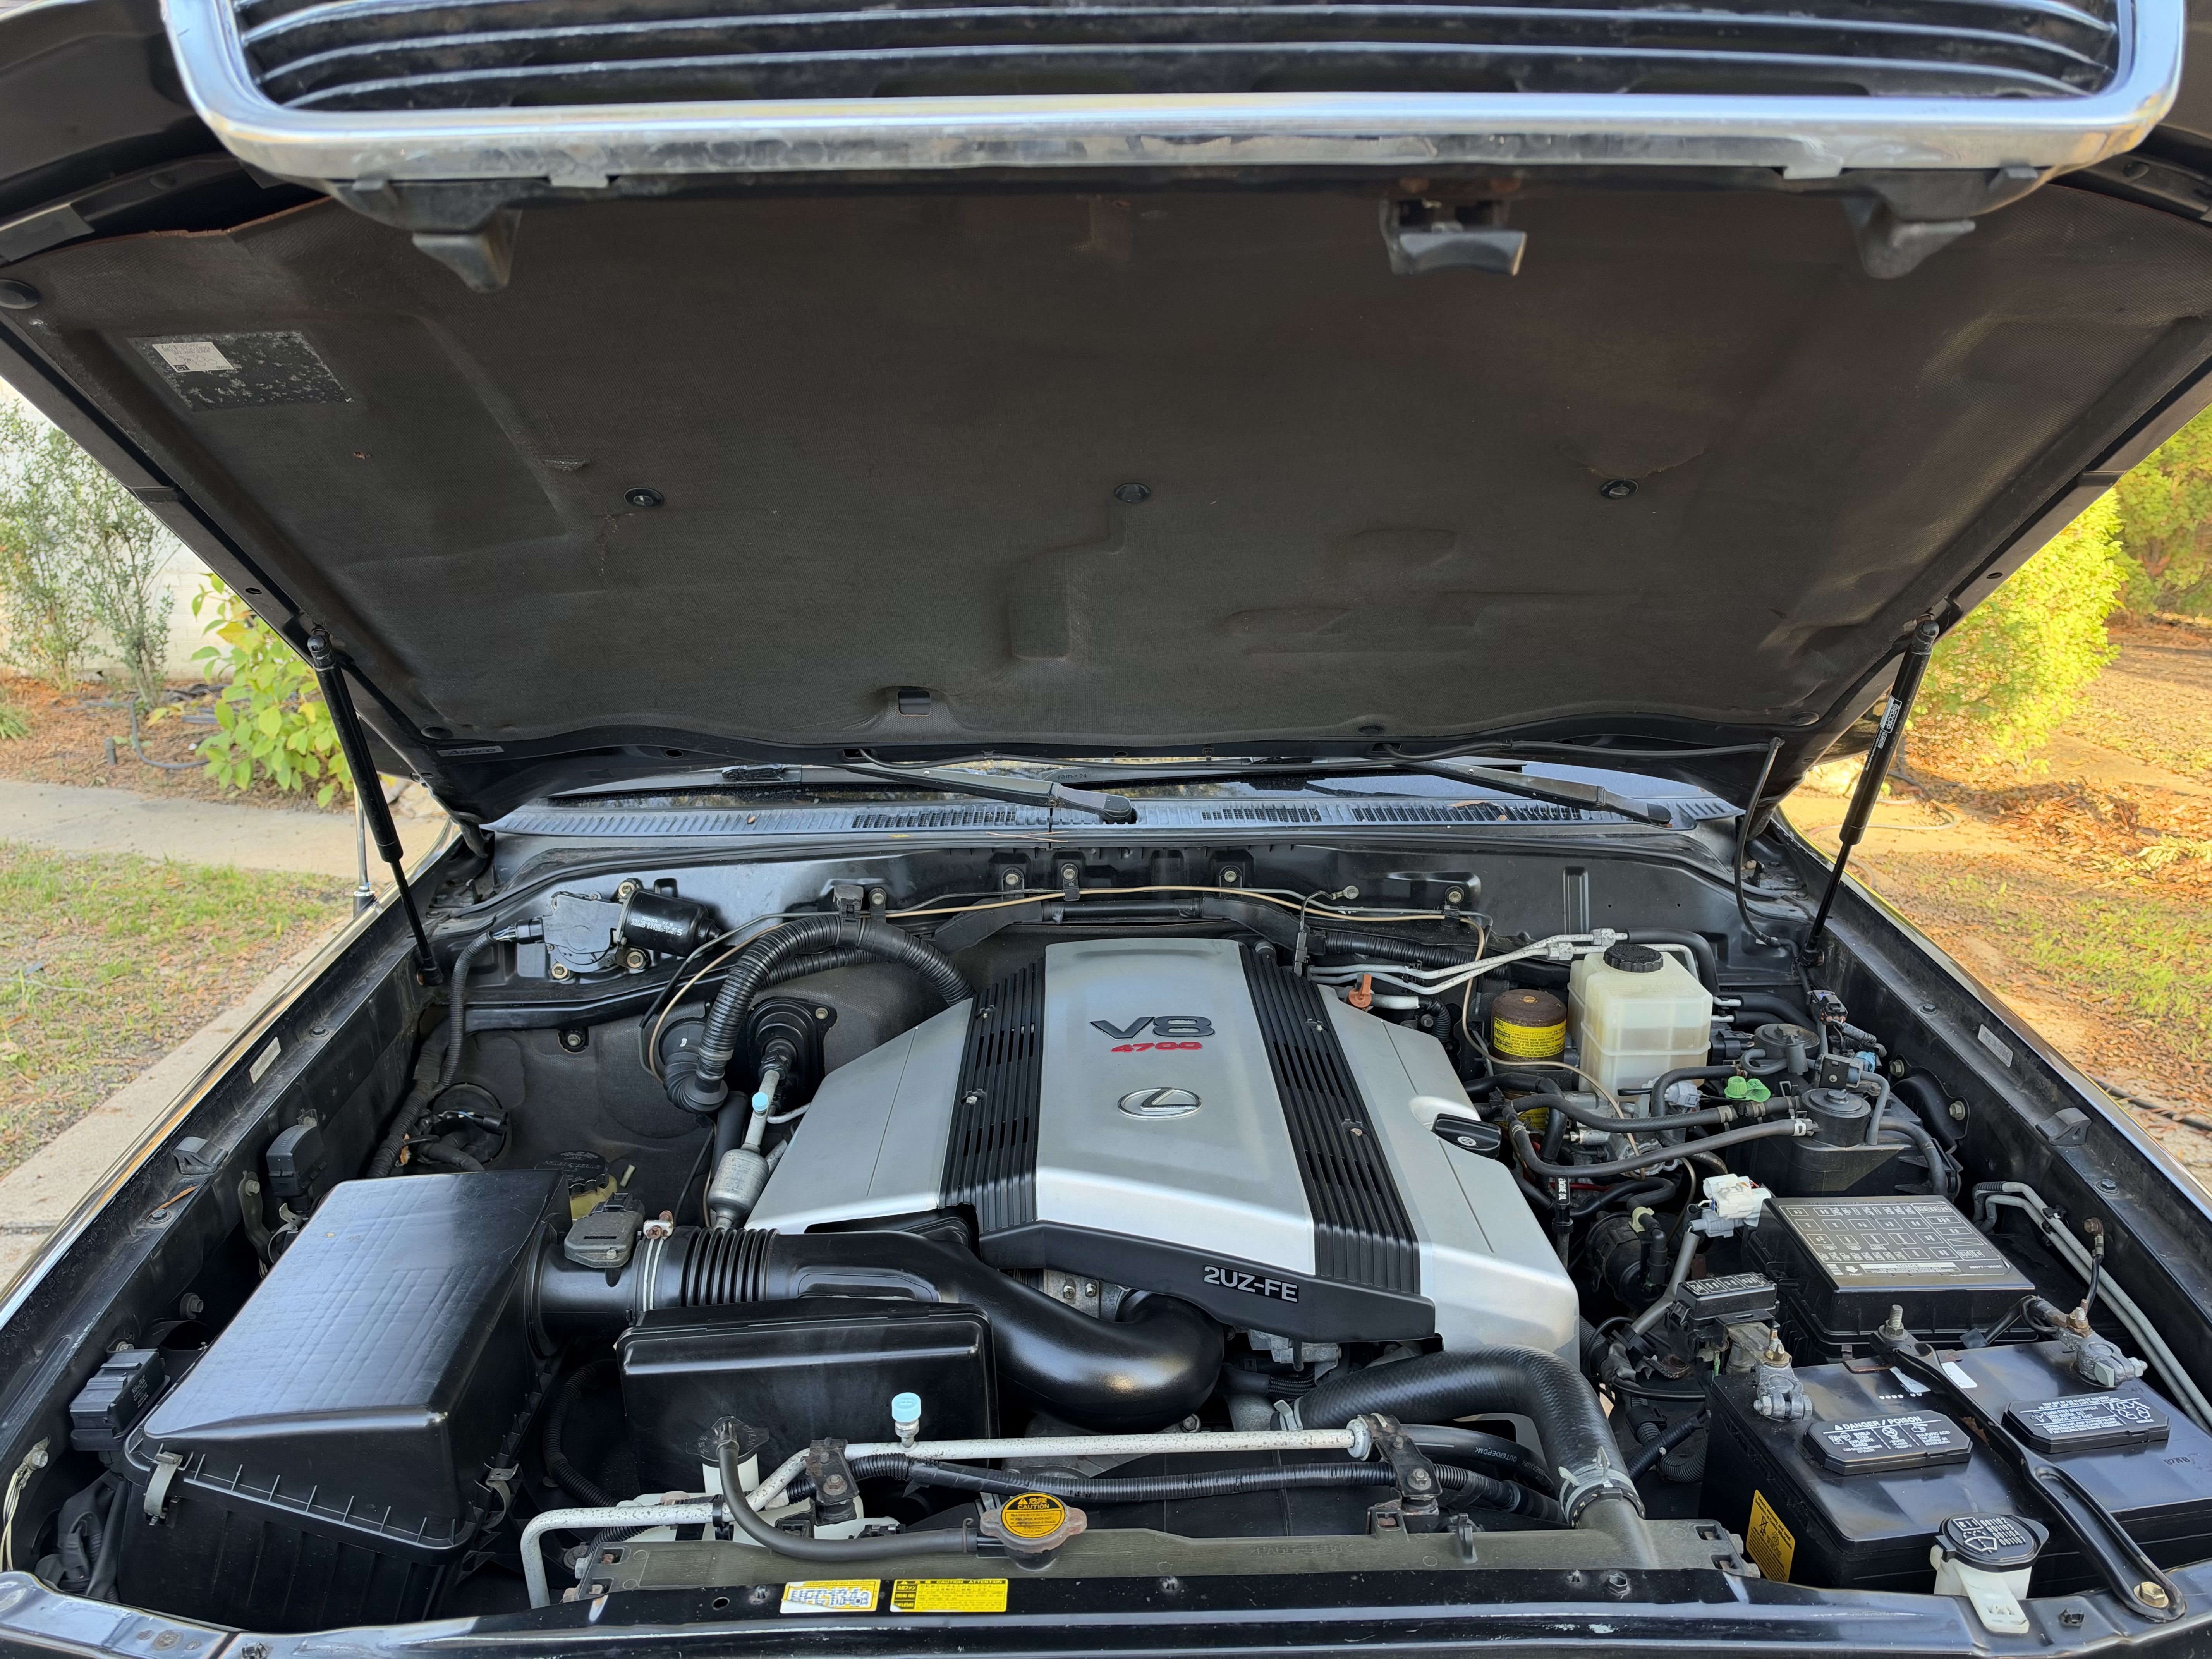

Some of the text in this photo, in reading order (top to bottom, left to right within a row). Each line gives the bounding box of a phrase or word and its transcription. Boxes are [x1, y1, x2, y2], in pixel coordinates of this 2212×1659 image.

[1886, 709, 1897, 730] ECCPP
[1090, 1015, 1216, 1041] V8
[1111, 1041, 1203, 1053] 4700
[1558, 1178, 1567, 1193] ENGINE
[1204, 1266, 1298, 1303] 2UZ-FE
[1842, 1420, 1881, 1430] DANGER
[1887, 1416, 1922, 1425] POISON
[1980, 1517, 2008, 1527] 001102
[1986, 1523, 2014, 1533] 001103
[1992, 1530, 2021, 1539] 001104
[1998, 1535, 2027, 1546] 001107
